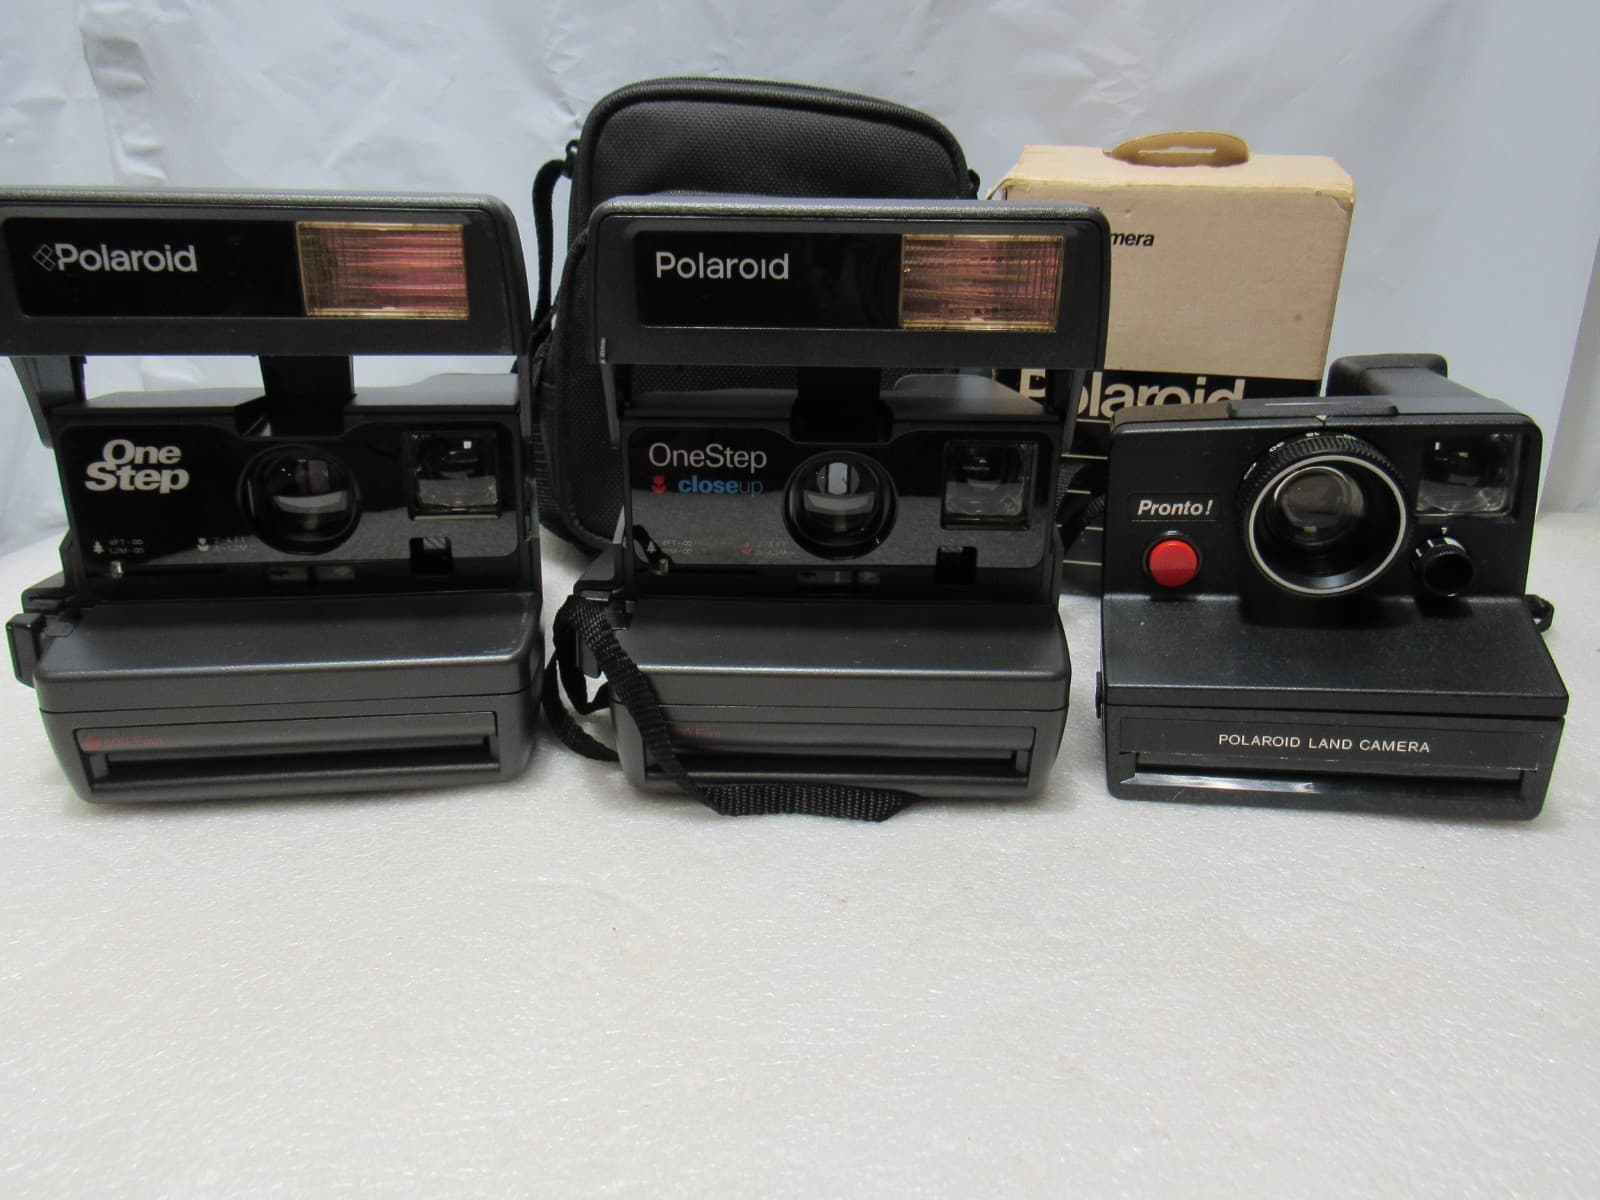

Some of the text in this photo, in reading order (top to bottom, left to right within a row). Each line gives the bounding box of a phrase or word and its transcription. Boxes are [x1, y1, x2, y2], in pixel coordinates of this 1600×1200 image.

[55, 243, 198, 272] Polaroid
[655, 251, 789, 280] Polaroid
[103, 439, 182, 465] One
[648, 442, 767, 473] OneStep
[84, 461, 190, 494] Step
[678, 475, 764, 497] closeup
[1137, 499, 1214, 516] Pronto!
[1218, 734, 1431, 753] POLAROID LAND CAMERA
